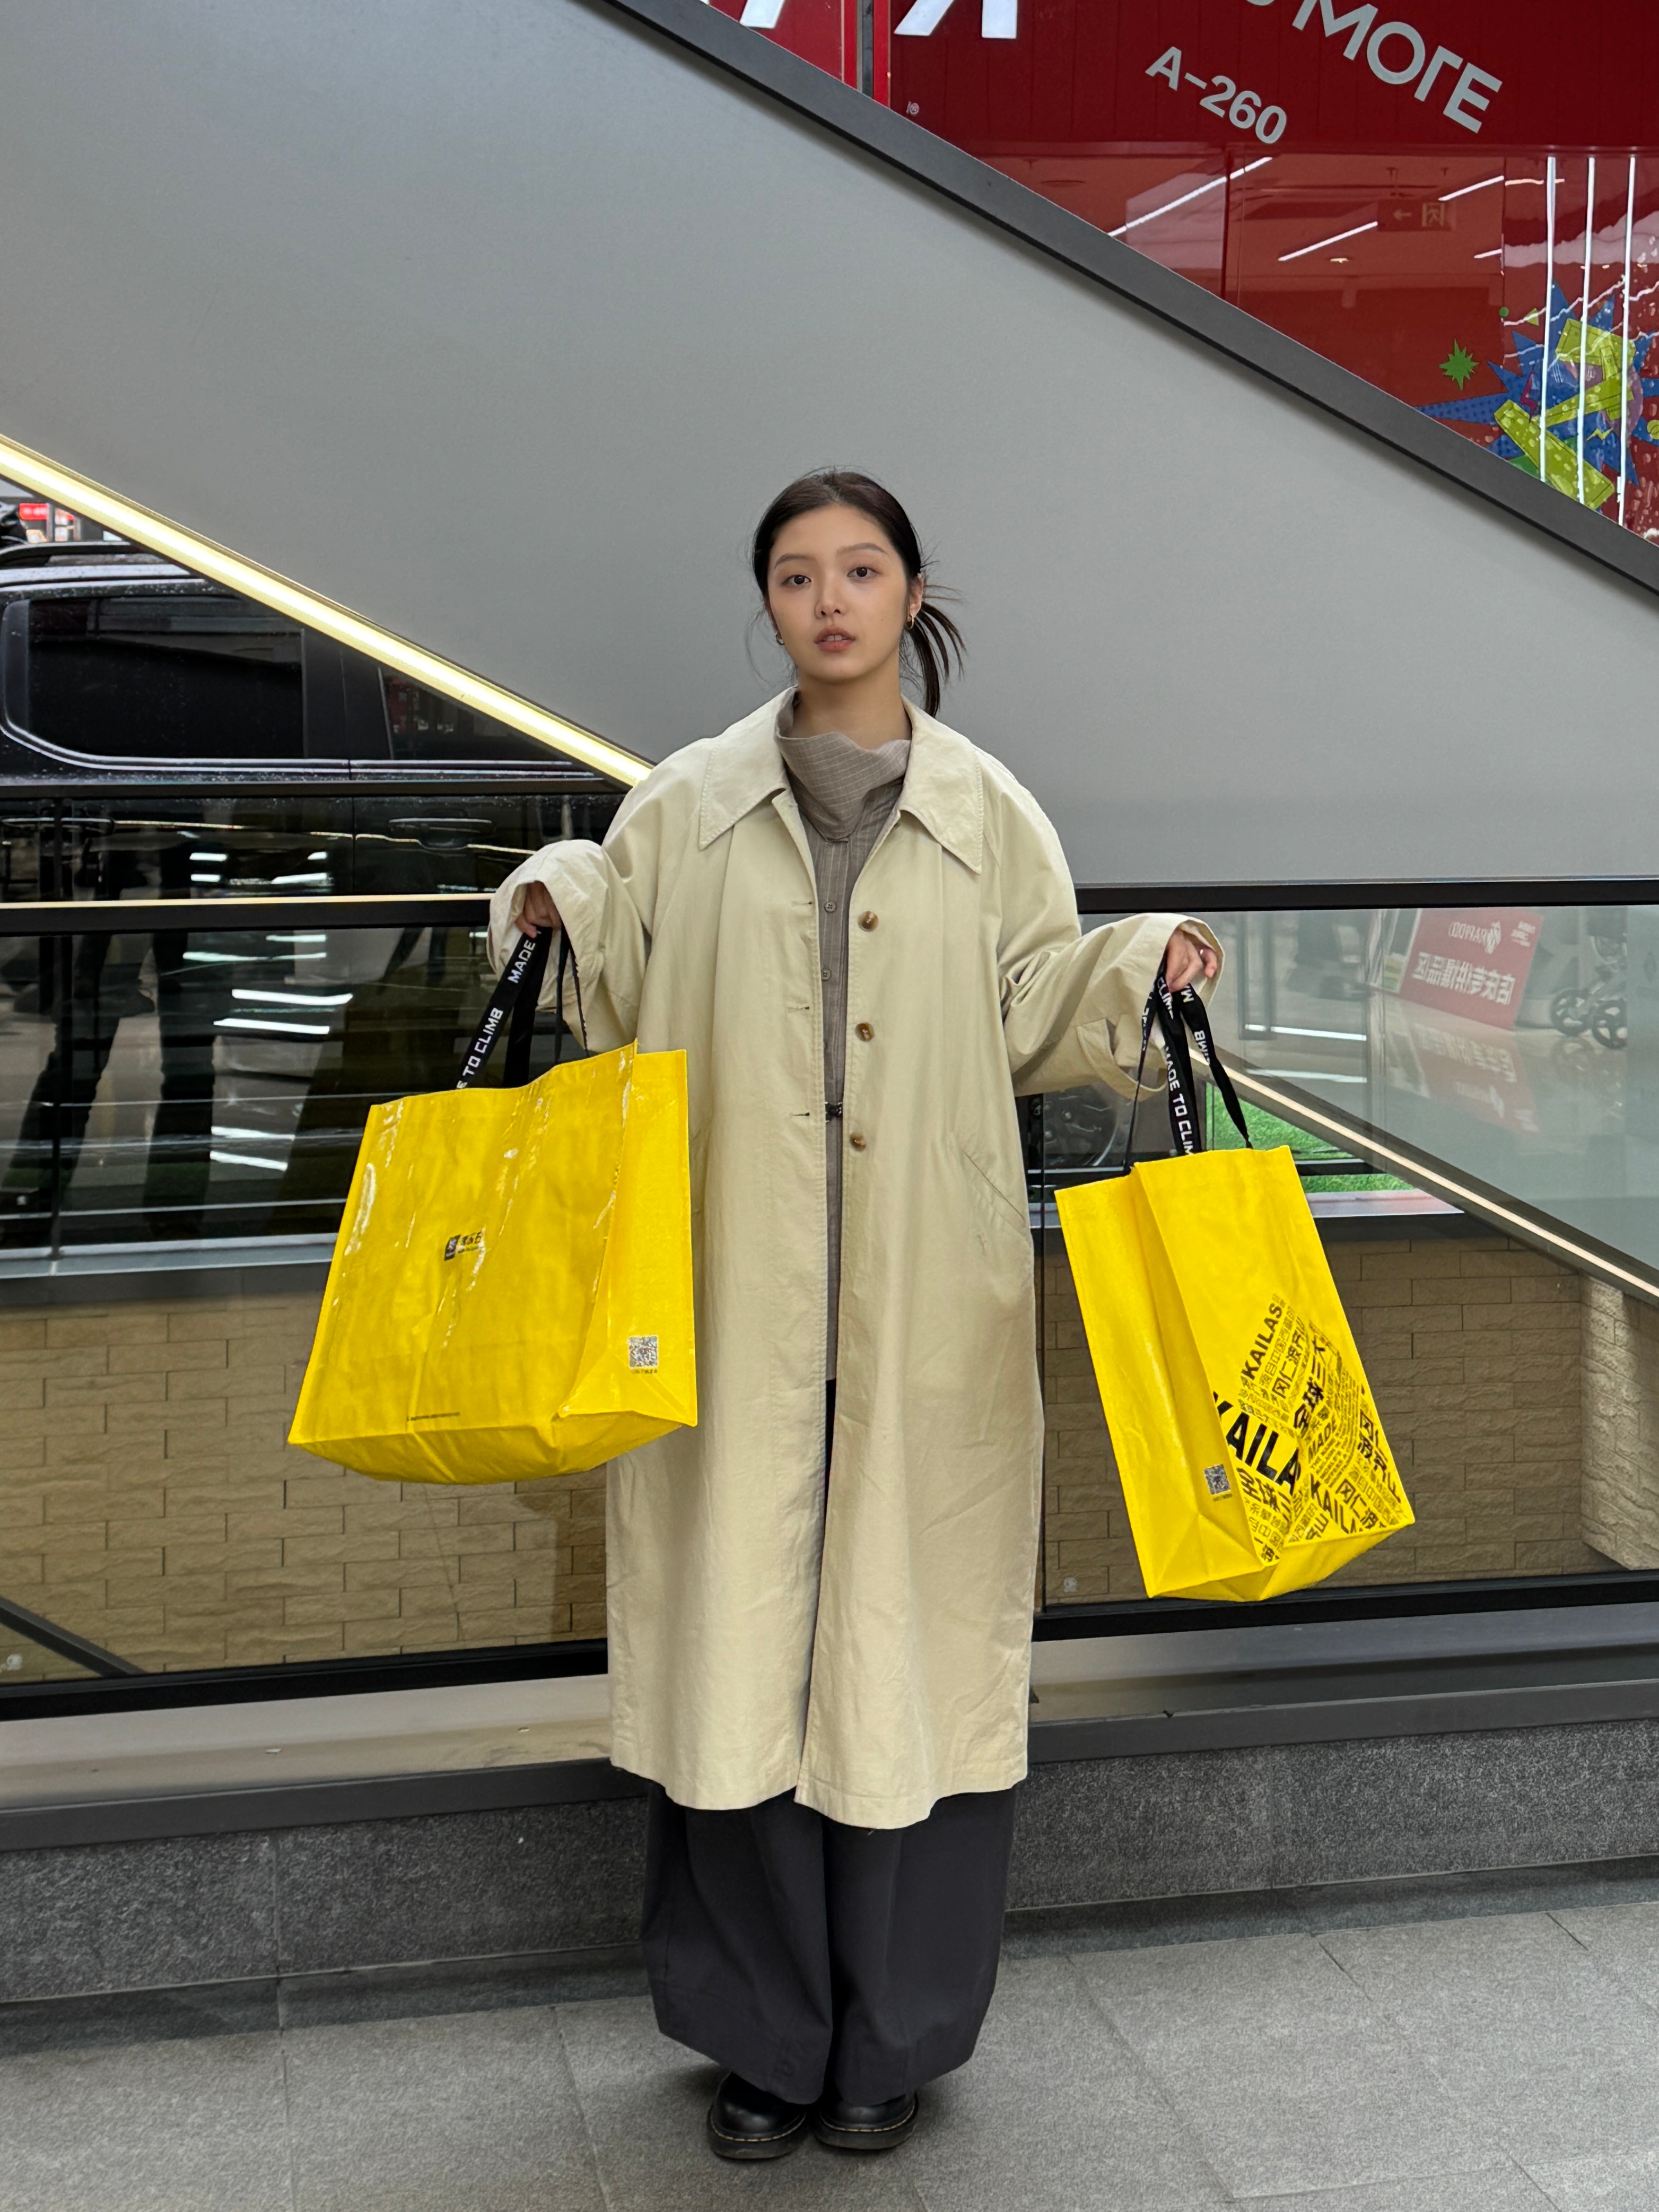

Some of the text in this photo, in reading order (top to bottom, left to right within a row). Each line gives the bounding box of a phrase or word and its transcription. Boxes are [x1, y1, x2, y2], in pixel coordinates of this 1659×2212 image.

[1145, 46, 1287, 144] A-260
[462, 939, 536, 1076] TO CLIMB MADE
[1172, 1093, 1188, 1116] TO
[1241, 1302, 1282, 1380] KAILAS
